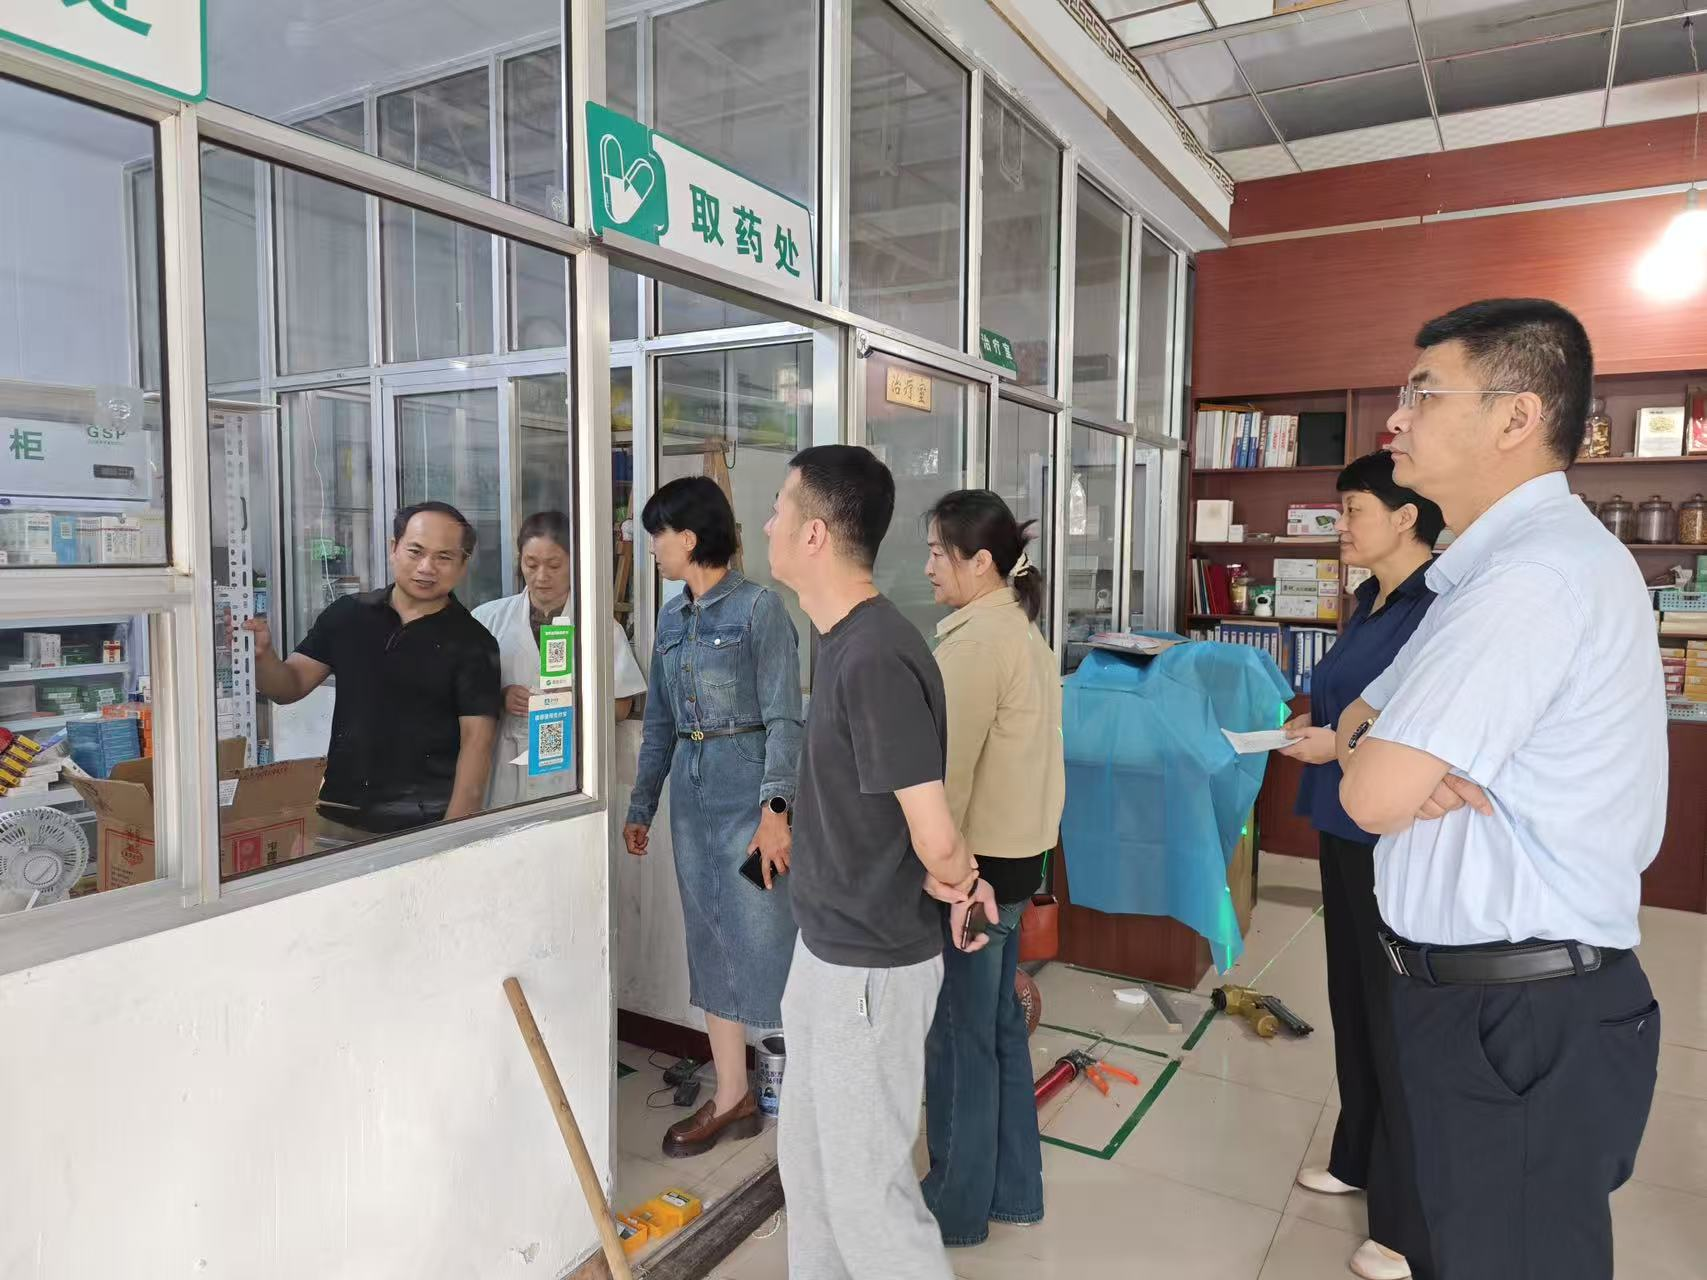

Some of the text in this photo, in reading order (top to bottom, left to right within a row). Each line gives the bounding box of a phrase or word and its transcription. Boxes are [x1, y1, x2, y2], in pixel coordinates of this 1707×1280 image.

[689, 183, 801, 278] 取药处
[980, 333, 1014, 360] 治疗室
[889, 376, 927, 404] 治疗室
[9, 428, 45, 461] 柜
